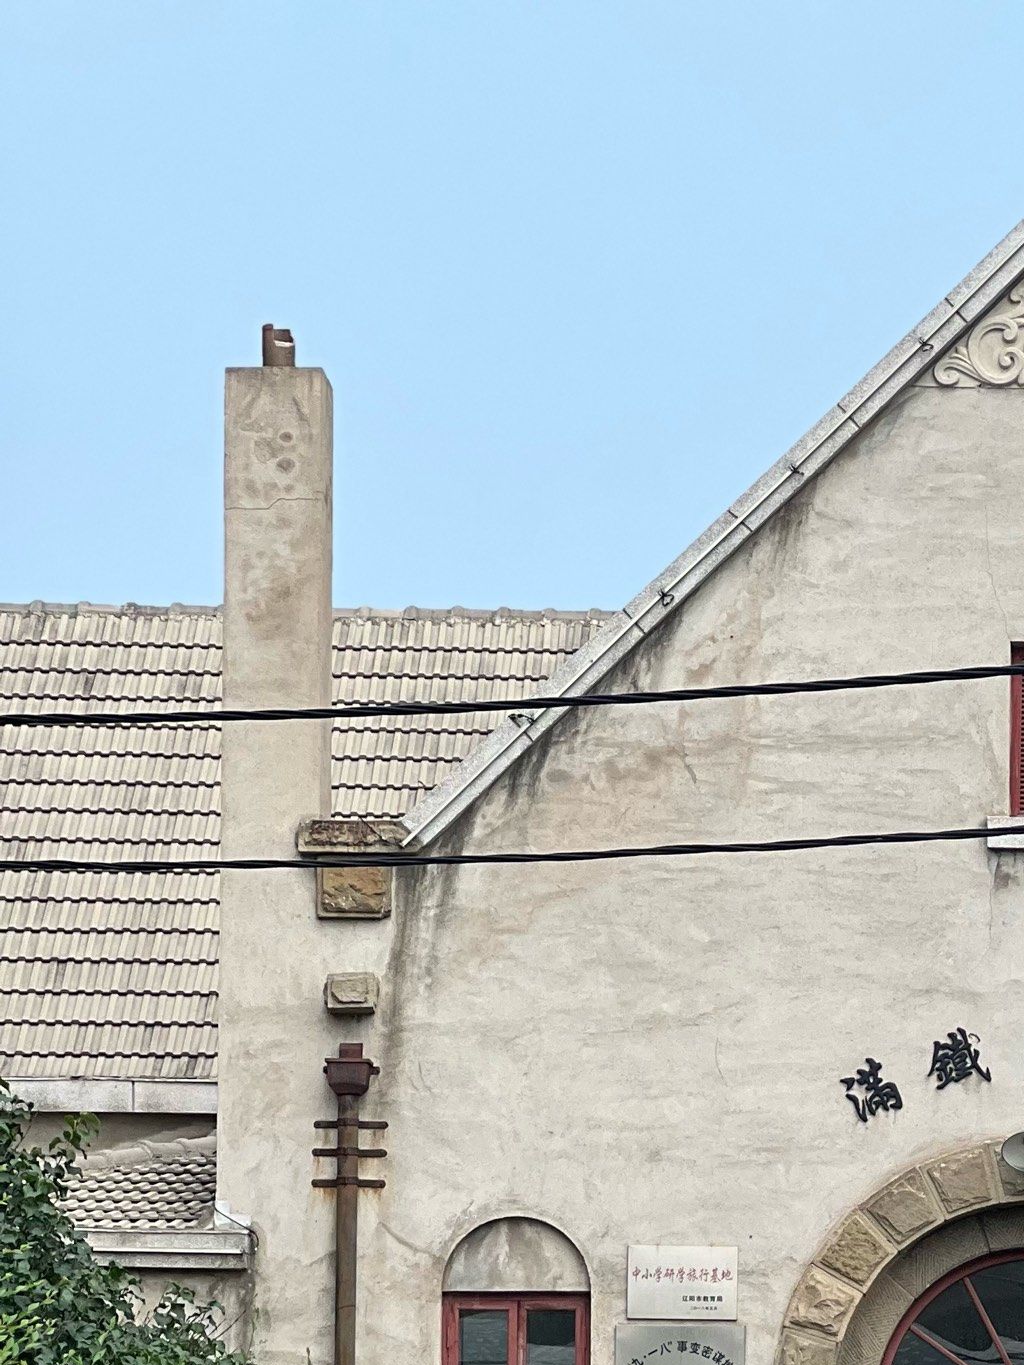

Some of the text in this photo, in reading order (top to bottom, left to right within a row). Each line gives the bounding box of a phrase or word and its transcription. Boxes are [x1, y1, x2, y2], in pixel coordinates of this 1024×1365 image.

[632, 1266, 733, 1283] 中小学研学旅行基地
